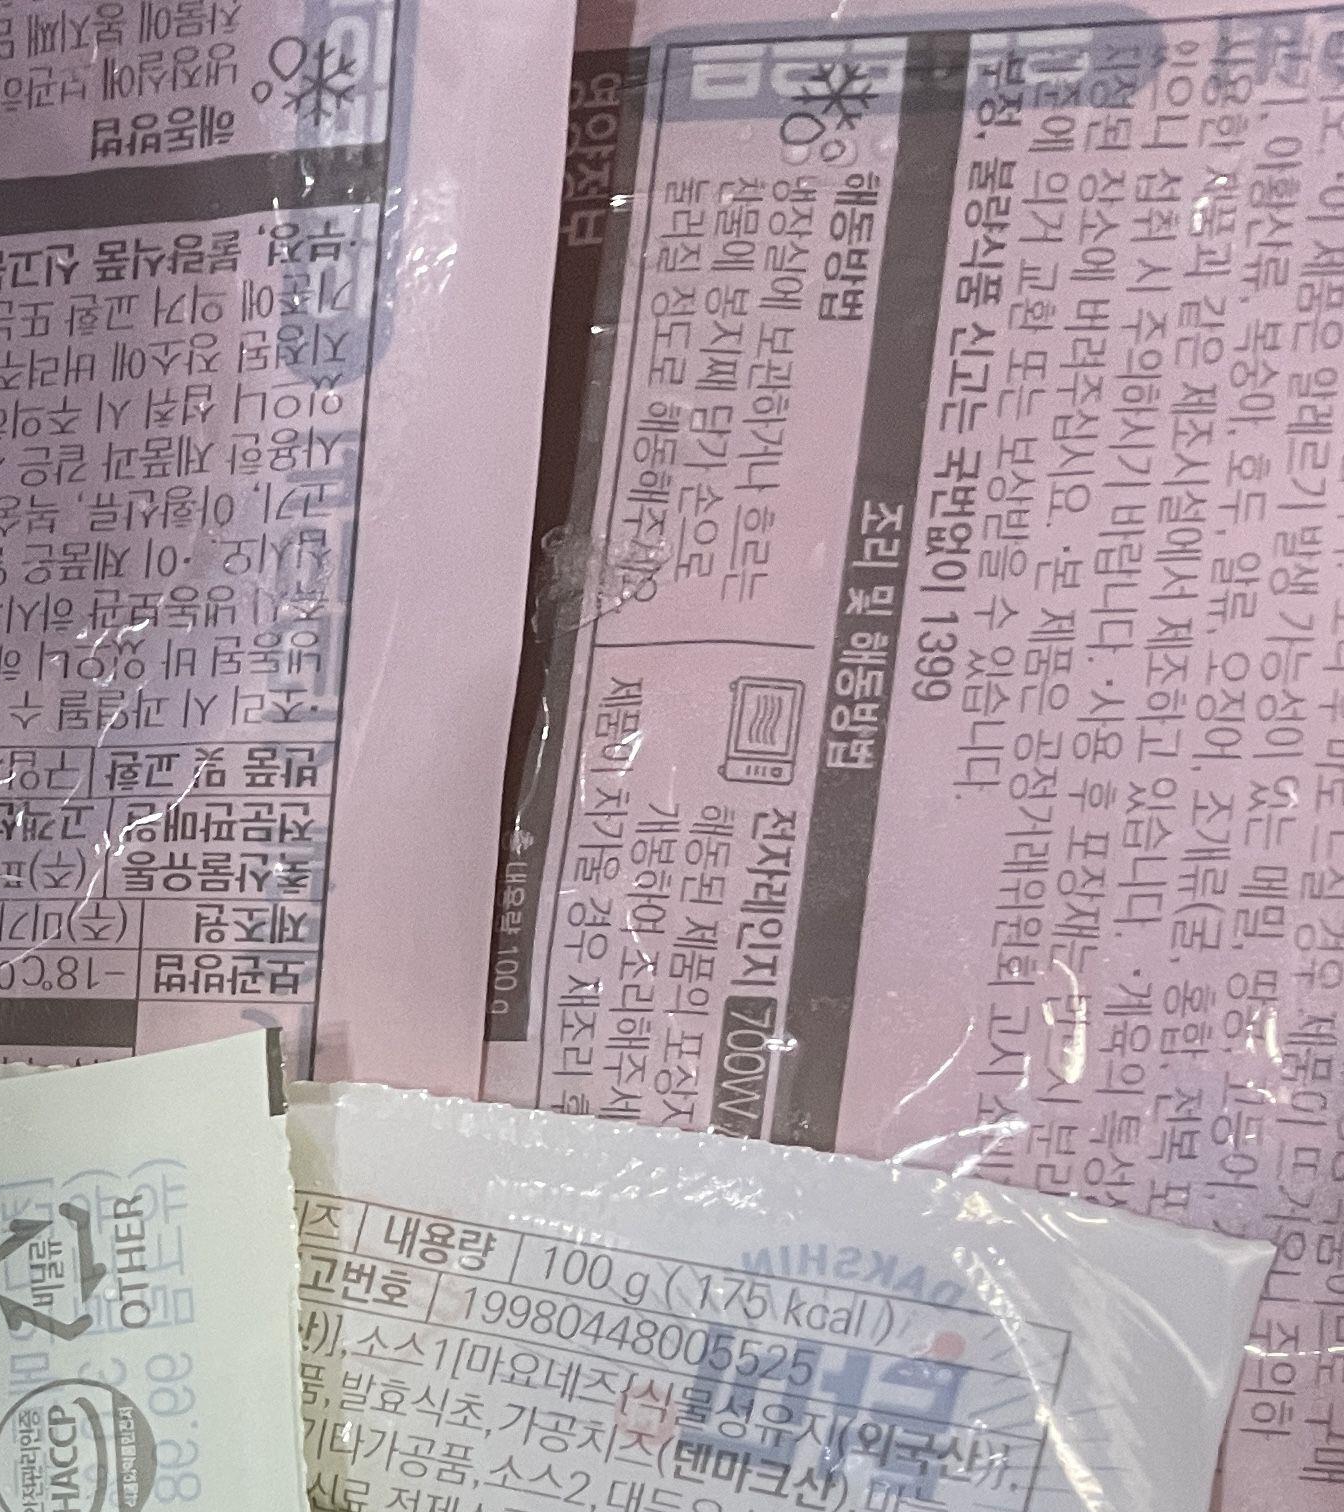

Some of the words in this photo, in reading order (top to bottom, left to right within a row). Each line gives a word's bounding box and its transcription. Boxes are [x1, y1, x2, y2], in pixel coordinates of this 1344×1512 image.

[696, 287, 749, 392] 봉지째
[940, 323, 995, 434] 신고는
[735, 325, 795, 491] 보관하거나
[1278, 367, 1338, 510] 알레르기
[674, 484, 723, 581] 손으로
[853, 501, 903, 568] 조리
[921, 449, 981, 593] 국번없이
[1151, 383, 1217, 601] 제조시설에서
[720, 505, 776, 601] 흐르는
[846, 588, 894, 616] 및
[1269, 525, 1322, 596] 발생
[827, 632, 887, 769] 해동방법
[912, 613, 959, 702] 1399
[680, 805, 729, 906] 해동된
[733, 809, 796, 986] 전자레인지
[665, 917, 718, 1016] 제품의
[719, 1012, 770, 1119] 700W
[28, 1241, 64, 1307] 비닐류
[113, 1194, 151, 1329] OTHER
[384, 1216, 496, 1272] 내용량
[545, 1246, 614, 1290] 100
[466, 1288, 816, 1386] 19980448005525
